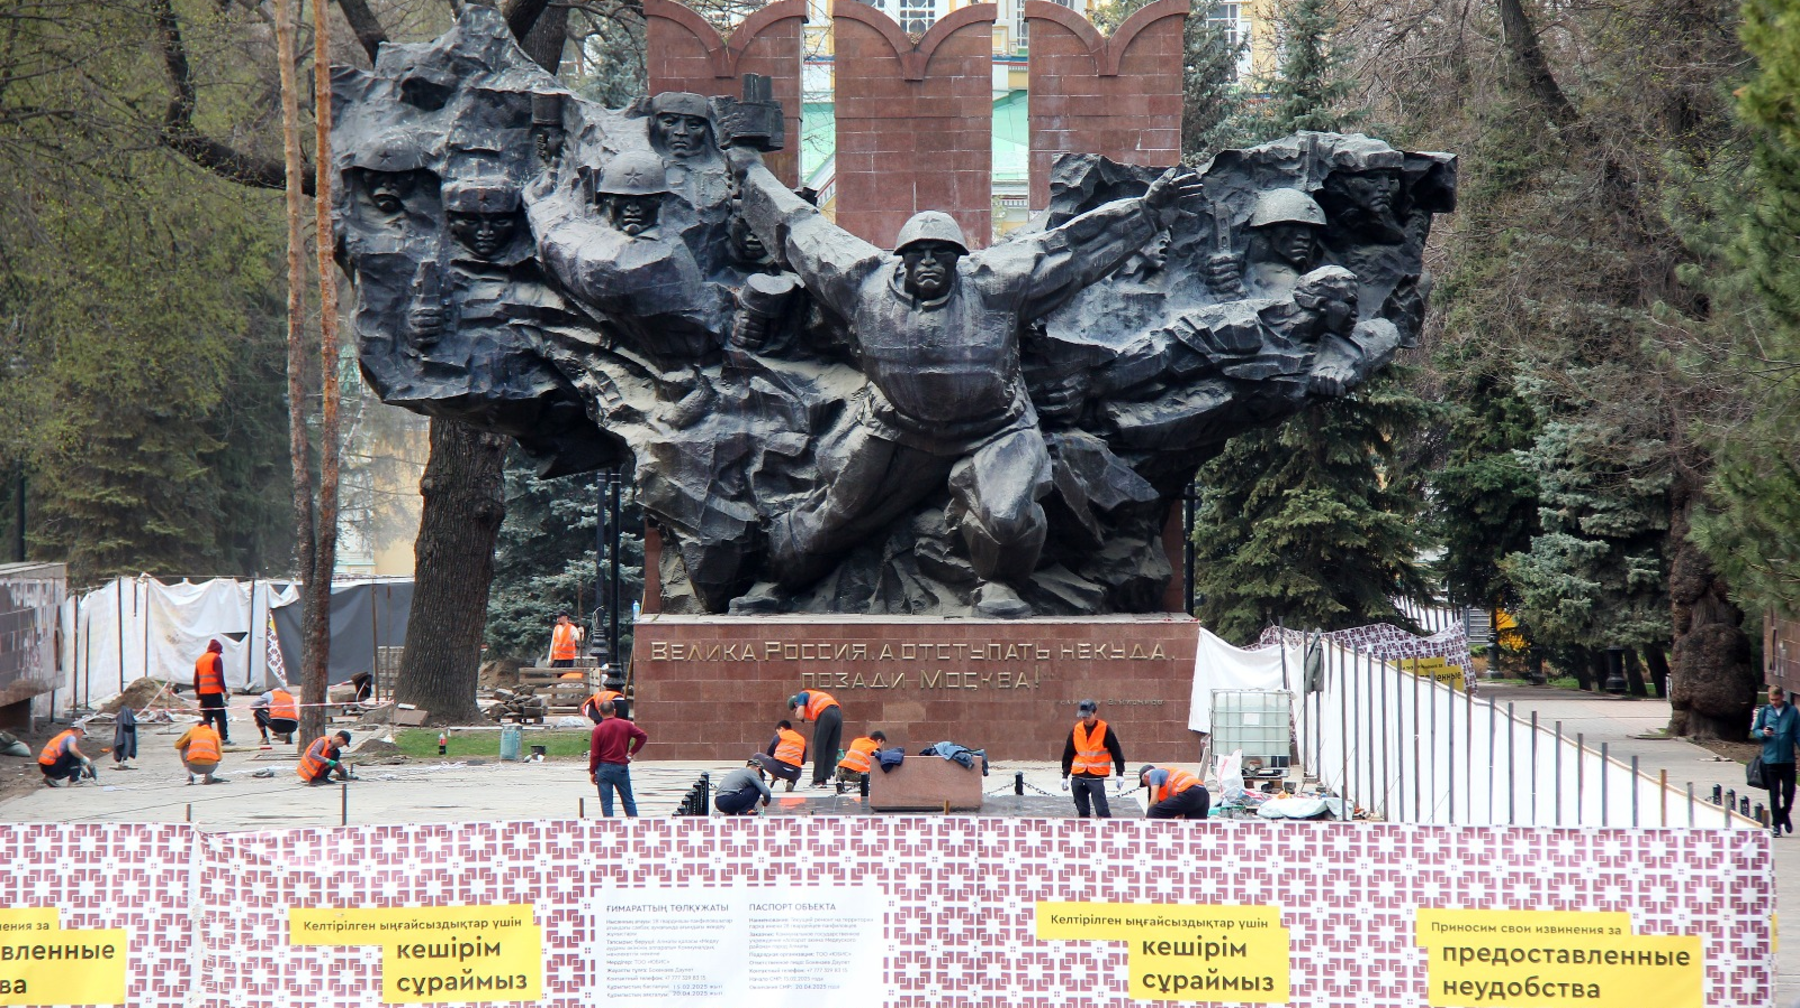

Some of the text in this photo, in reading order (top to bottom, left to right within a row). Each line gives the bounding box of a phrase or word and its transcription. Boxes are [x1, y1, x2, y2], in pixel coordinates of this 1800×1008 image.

[879, 643, 895, 660] А
[901, 643, 1050, 660] ОТСТУПАТЬ
[802, 672, 906, 689] ПОЗАДИ
[748, 903, 836, 911] ПАСПОРТ ОБЪЕКТА
[36, 922, 50, 930] за
[303, 916, 522, 933] Келтірілген ыңғайсыздықтар үшін
[1050, 914, 1269, 930] Келтірілген ыңғайсыздықтар үшін
[1431, 921, 1622, 935] Приносим свои извинения за
[396, 936, 501, 962] кешірім
[1142, 935, 1247, 960] кешірім
[1443, 946, 1690, 966] предоставленные
[396, 969, 528, 996] сұраймыз
[1142, 968, 1274, 993] сұраймыз
[1443, 976, 1600, 1000] неудобства
